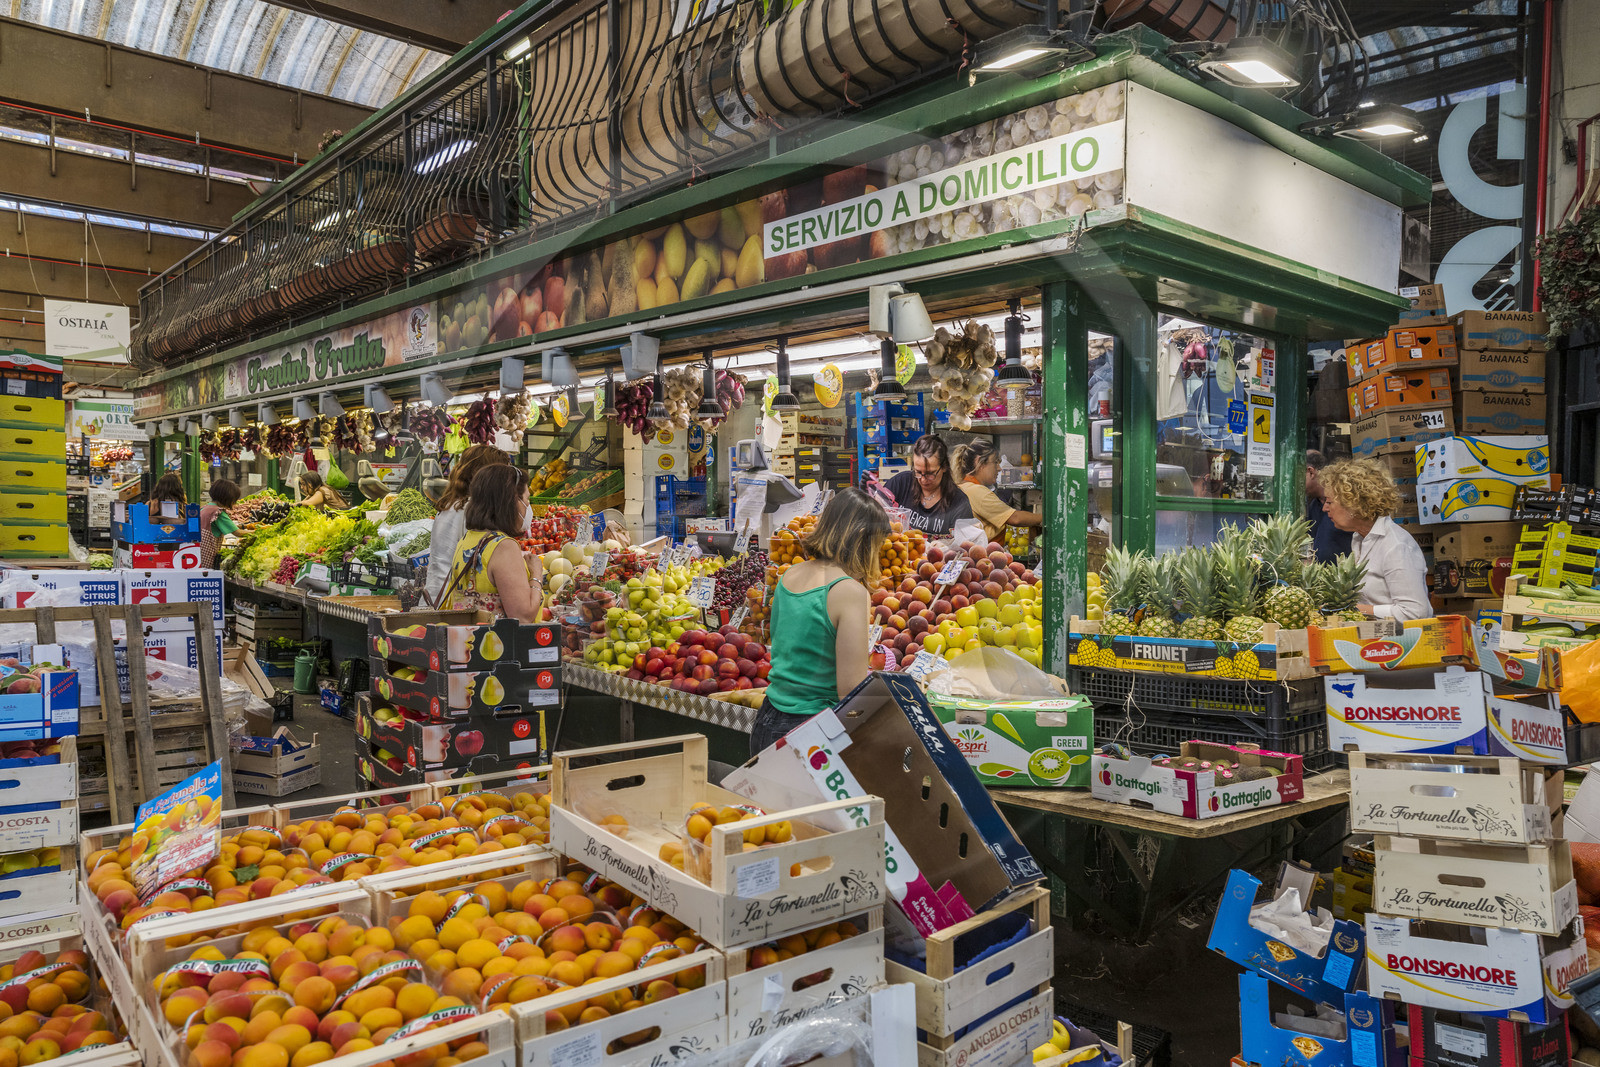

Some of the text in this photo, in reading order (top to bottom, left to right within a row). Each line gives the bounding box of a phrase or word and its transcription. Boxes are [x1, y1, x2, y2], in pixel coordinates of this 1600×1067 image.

[769, 136, 1100, 254] SERVIZIO A DOMICILIO
[58, 316, 109, 331] OSTAIA
[1485, 312, 1534, 322] BANANAS
[313, 329, 387, 381] Frutta
[1479, 354, 1529, 364] BANANAS
[1490, 373, 1516, 384] ROSY
[1251, 394, 1274, 407] ATTENZIONE
[1483, 395, 1532, 407] BANANAS
[1231, 409, 1245, 423] 777
[1422, 413, 1444, 426] R14
[1356, 420, 1378, 434] BANANAS
[686, 524, 700, 534] Dole
[932, 518, 944, 532] IN
[131, 578, 167, 588] unifrutti
[144, 638, 166, 646] frutti
[1134, 644, 1188, 662] FRUNET
[1344, 706, 1462, 722] BONSIGNORE
[1512, 718, 1564, 748] BONSIGNORE
[1056, 738, 1082, 748] GREEN
[139, 806, 153, 820] La
[155, 776, 207, 809] Fortunella
[1222, 786, 1272, 808] Battaglio
[1364, 804, 1471, 824] La Fortunella
[7, 816, 51, 828] COSTA
[584, 834, 650, 886] La Fortunella
[739, 882, 842, 928] La Fortunella
[912, 900, 920, 912] da
[1390, 888, 1498, 914] La Fortunella
[918, 896, 937, 922] Frutta
[8, 924, 51, 937] COSTA
[1387, 953, 1518, 986] BONSIGNORE
[968, 1005, 1041, 1056] ANGELO COSTA
